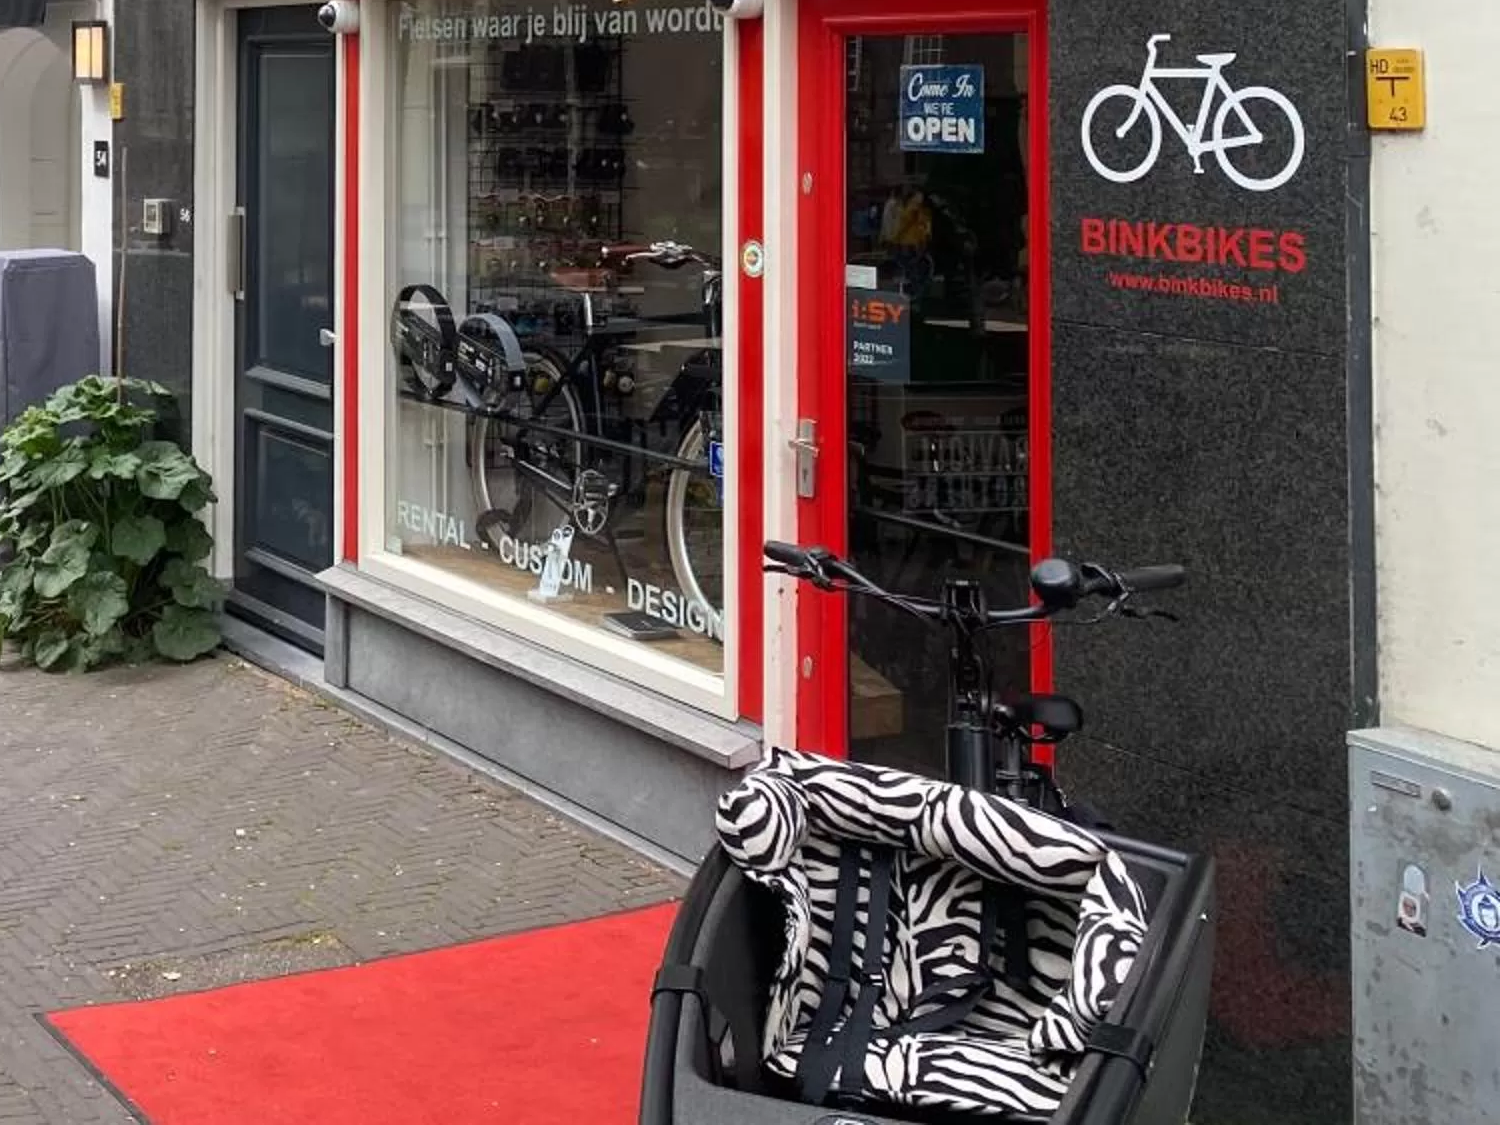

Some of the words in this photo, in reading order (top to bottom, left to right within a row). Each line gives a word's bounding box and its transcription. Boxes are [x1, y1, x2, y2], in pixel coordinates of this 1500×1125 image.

[473, 14, 521, 39] waar
[526, 6, 546, 44] je
[553, 4, 587, 44] blij
[594, 10, 637, 35] van
[646, 4, 723, 34] wordt
[907, 72, 949, 102] Come
[952, 74, 977, 98] In
[907, 116, 975, 144] OPEN
[1080, 218, 1307, 272] BINKBIKES
[1108, 271, 1279, 304] www.binkbikes.nl
[397, 500, 471, 550] RENTAL
[627, 577, 724, 643] DESIGN
